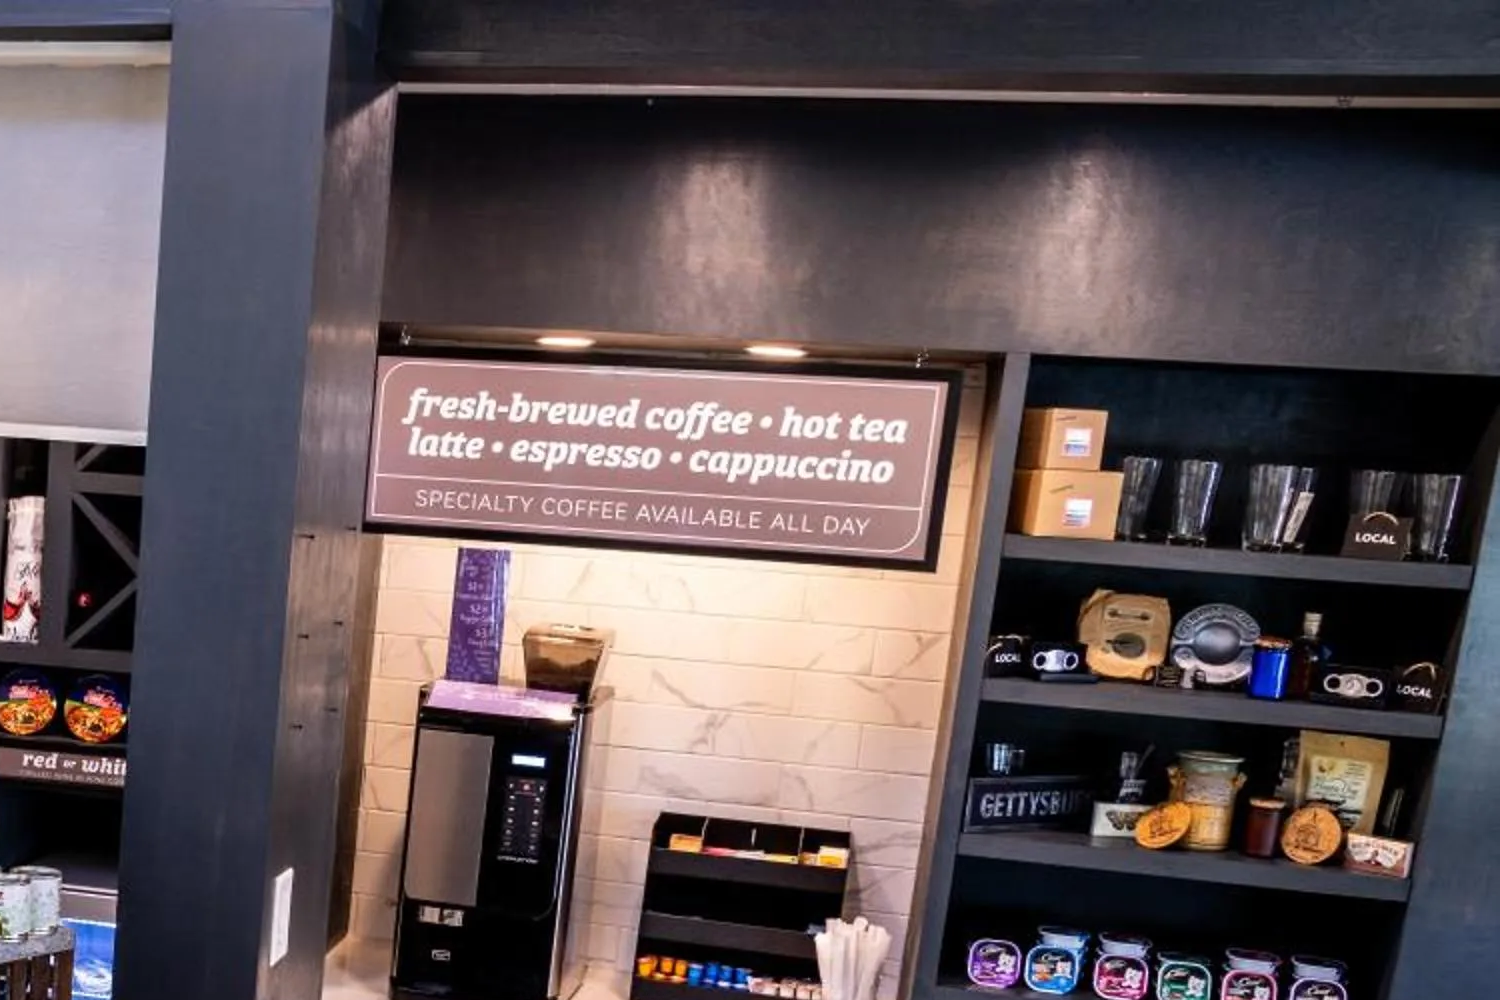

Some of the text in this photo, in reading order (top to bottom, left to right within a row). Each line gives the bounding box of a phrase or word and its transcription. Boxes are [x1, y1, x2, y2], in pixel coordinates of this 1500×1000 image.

[402, 388, 908, 445] fresh-brewed coffee hot tea
[408, 428, 895, 485] latte espresso cappuccino
[414, 489, 873, 537] SPECIALTY COFFEE AVAILABLE ALL DAY
[1355, 532, 1397, 546] LOCAL
[994, 652, 1022, 664] LOCAL
[1396, 684, 1432, 700] LOCAL
[22, 752, 58, 769] red
[63, 758, 77, 768] or
